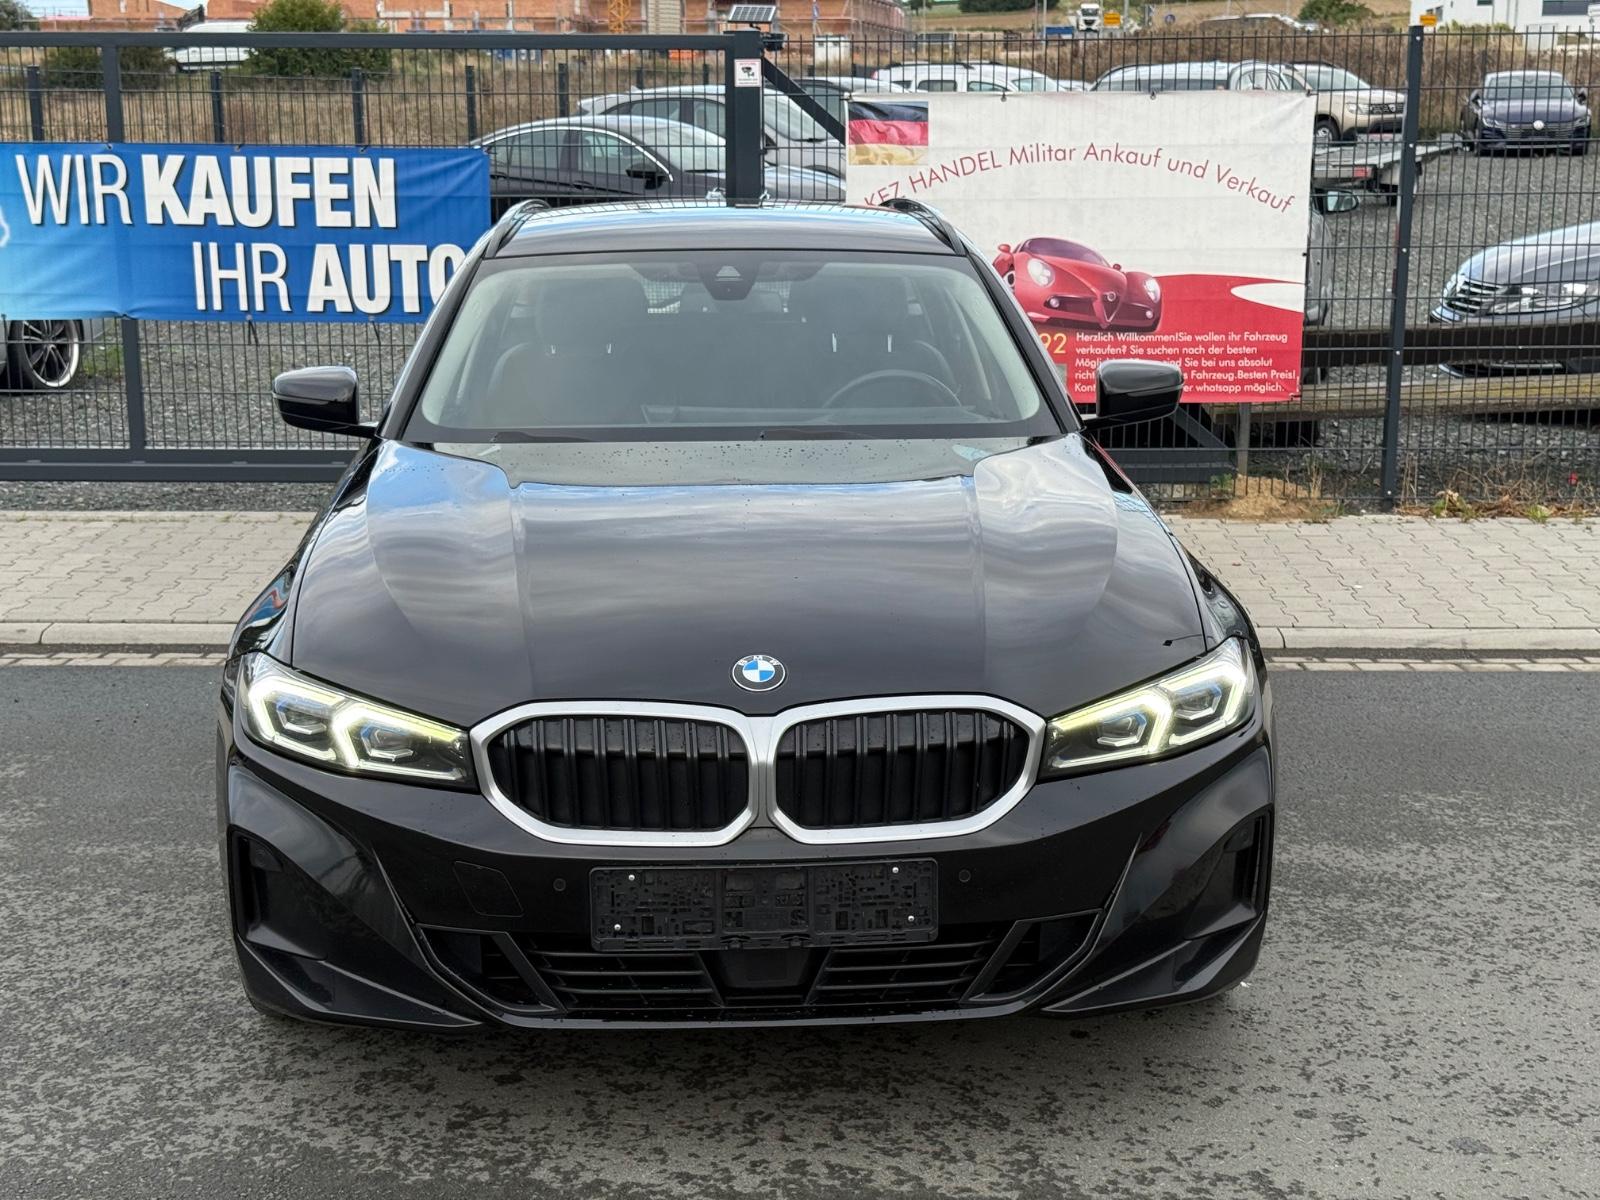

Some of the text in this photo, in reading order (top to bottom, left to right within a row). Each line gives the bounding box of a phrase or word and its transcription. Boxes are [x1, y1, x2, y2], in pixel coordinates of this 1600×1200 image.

[908, 150, 1002, 193] HANDEL
[1009, 142, 1077, 165] Militar
[1083, 142, 1163, 168] Ankauf
[1167, 156, 1210, 180] und
[1216, 167, 1296, 214] Verkauf
[15, 153, 398, 229] WIR KAUFEN
[193, 241, 467, 314] IHR AUTO
[1039, 333, 1067, 354] 92
[1076, 332, 1114, 342] Herzlich
[1195, 332, 1225, 342] wollen
[1229, 332, 1241, 342] ihr
[1244, 332, 1287, 344] Fahrzeug
[1076, 345, 1257, 355] verkaufen? Sie suchen nach der besten
[1185, 357, 1199, 367] Sie
[1202, 357, 1216, 367] bei
[1238, 357, 1272, 367] absolut
[1075, 370, 1095, 380] richt
[1075, 382, 1096, 392] Kont
[1196, 383, 1241, 394] whatsapp
[1244, 382, 1284, 394] möglich.
